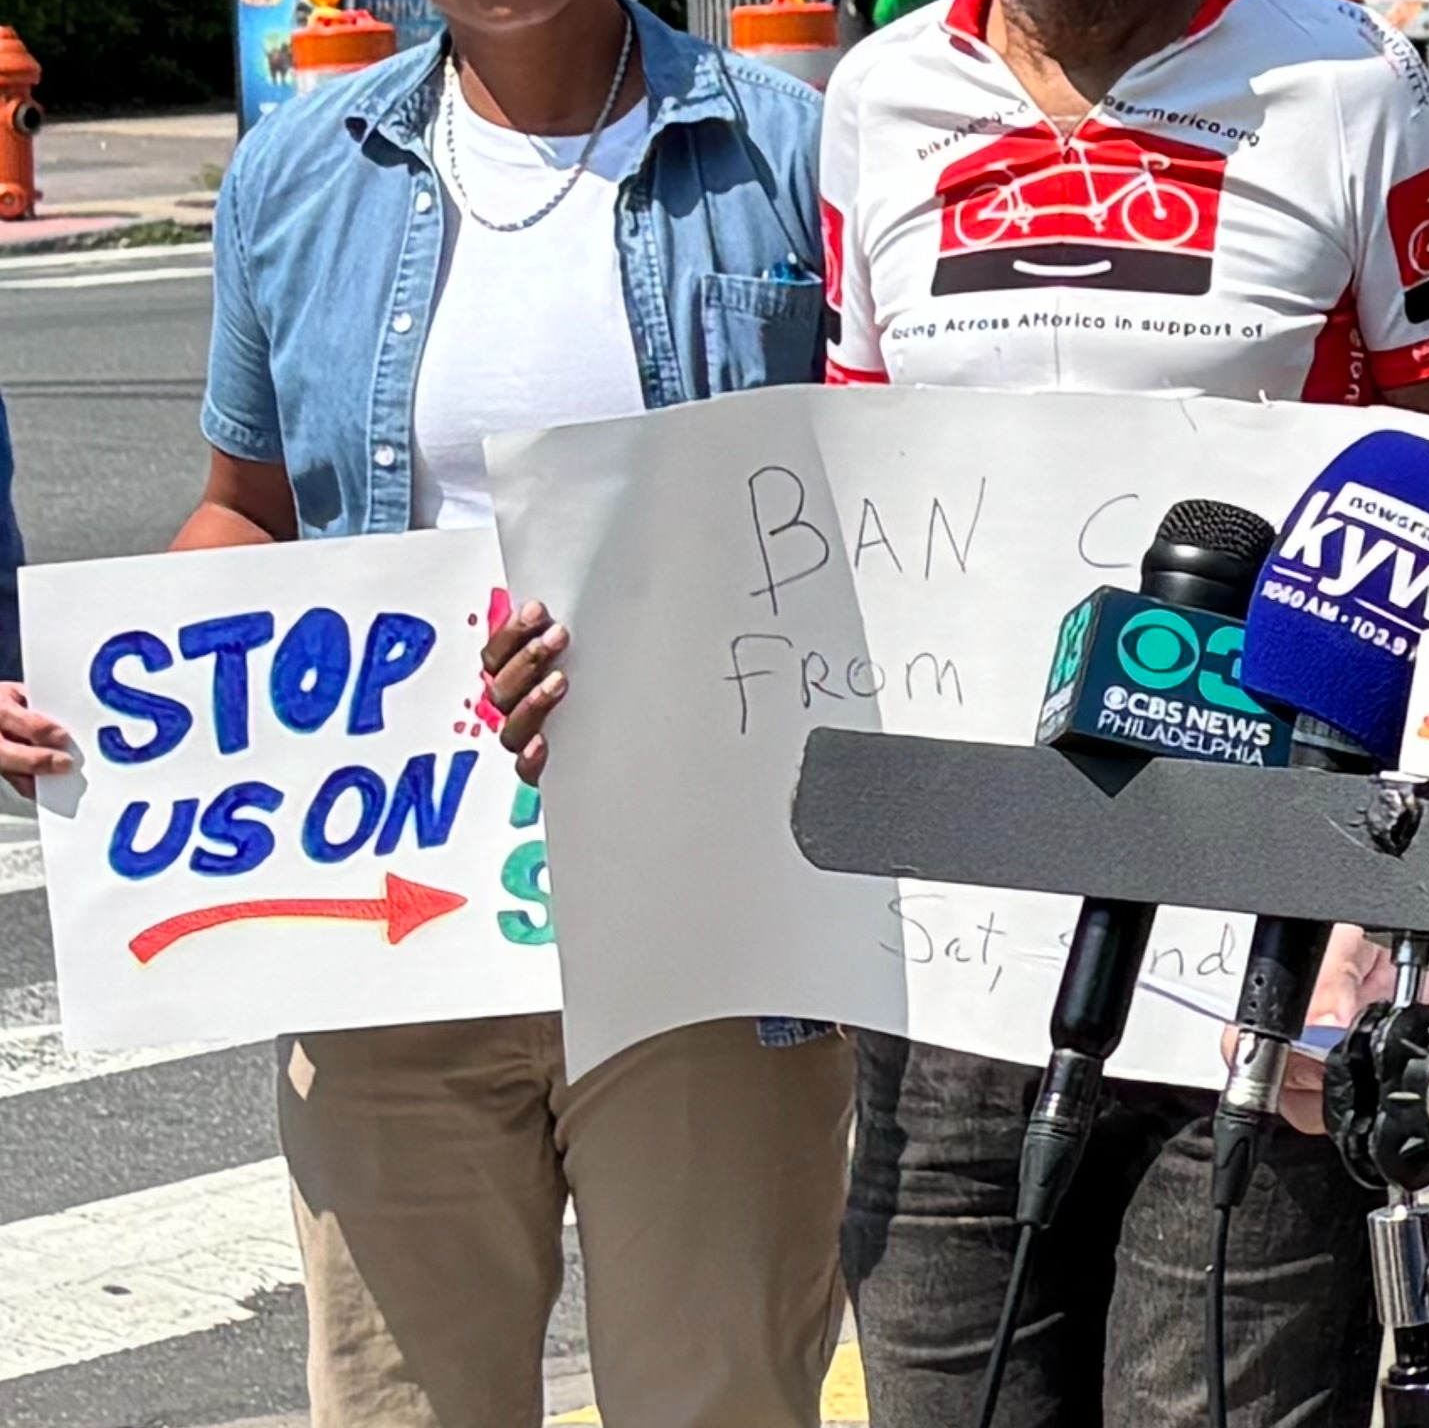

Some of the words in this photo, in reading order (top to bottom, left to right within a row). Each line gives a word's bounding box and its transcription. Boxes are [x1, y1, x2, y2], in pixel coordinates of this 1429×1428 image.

[1141, 319, 1232, 338] support
[1241, 322, 1263, 339] of
[748, 465, 988, 616] BAN
[1351, 616, 1408, 657] 103.9
[88, 606, 438, 766] STOP
[1097, 709, 1265, 768] PHILADELPHIA
[1127, 691, 1184, 726] CBS
[1186, 705, 1273, 746] NEWS
[107, 780, 285, 882] US
[301, 749, 480, 865] ON
